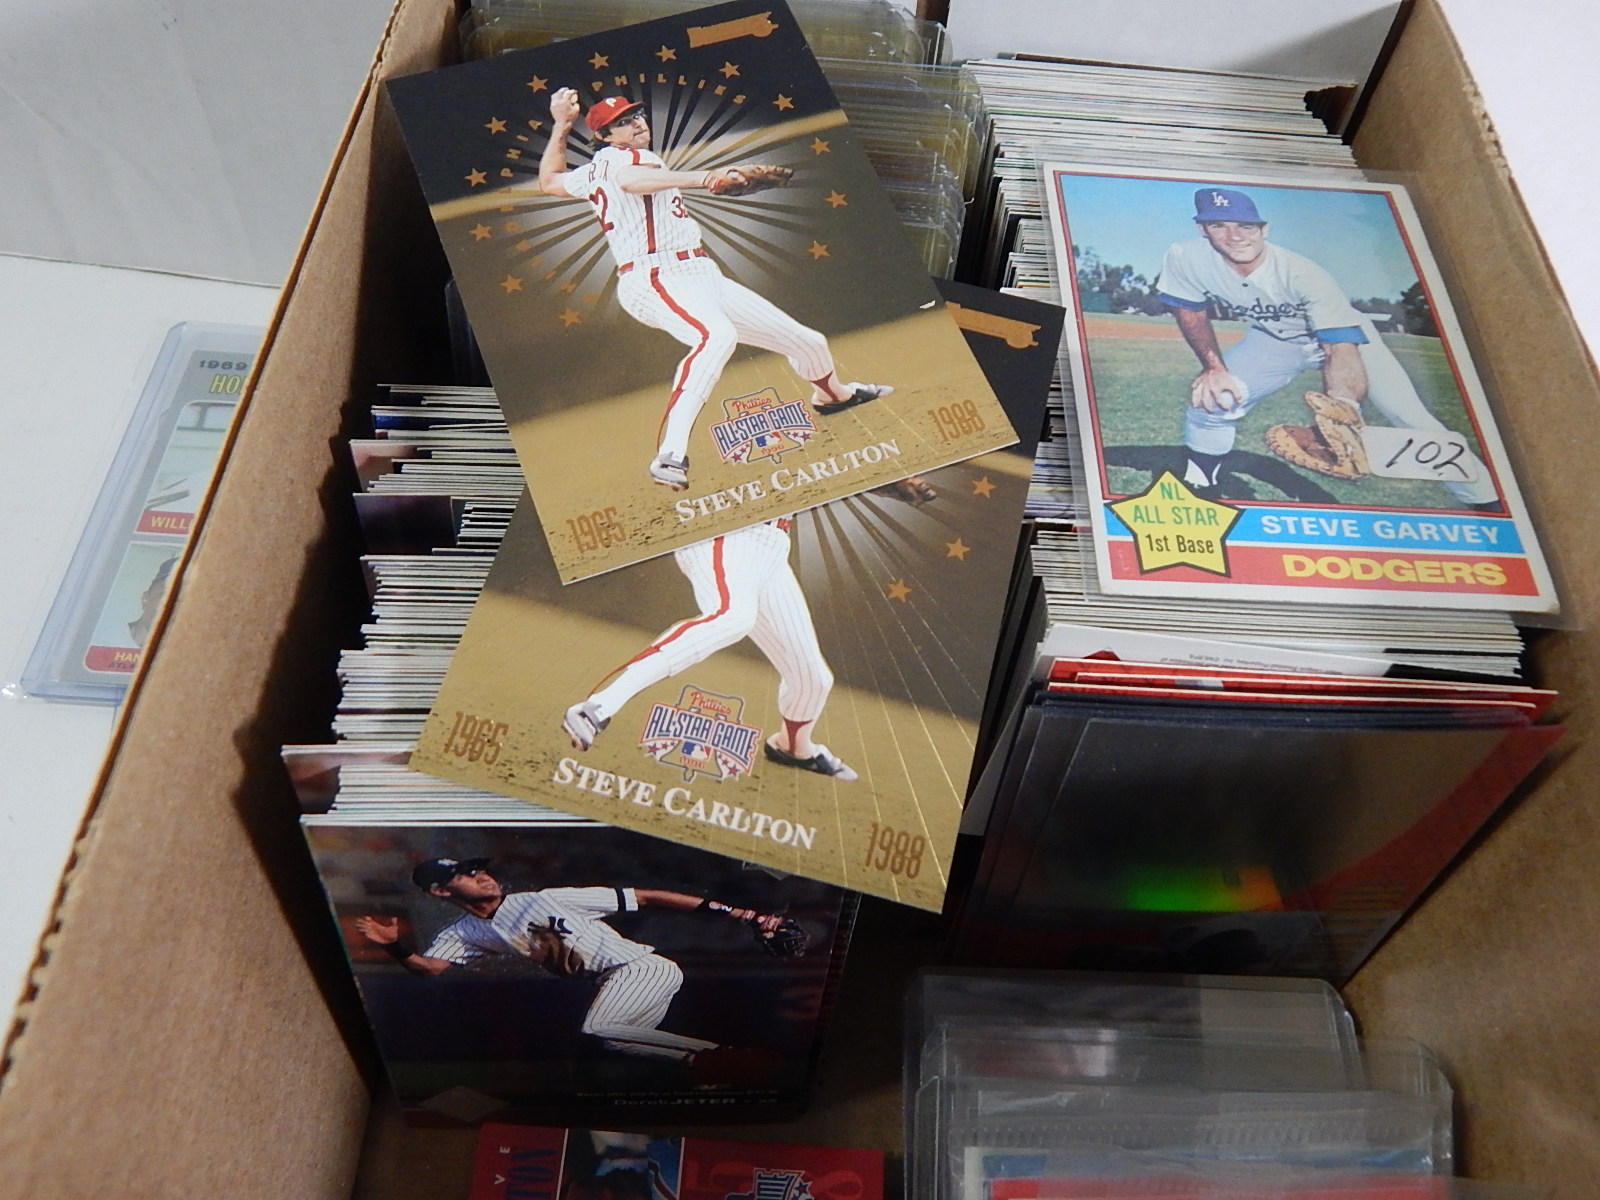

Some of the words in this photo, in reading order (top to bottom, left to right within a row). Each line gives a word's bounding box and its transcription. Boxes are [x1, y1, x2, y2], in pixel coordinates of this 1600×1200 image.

[767, 401, 813, 431] GAME
[929, 399, 987, 444] 1988
[674, 479, 768, 524] STEVE
[769, 437, 902, 493] CARLTON
[1160, 481, 1186, 501] NL
[569, 505, 627, 555] 1965
[1133, 504, 1167, 524] ALL
[1171, 506, 1220, 527] STAR
[1261, 514, 1362, 539] STEVE
[1372, 519, 1501, 546] GARVEY
[1145, 533, 1171, 552] 1st
[1176, 534, 1215, 554] Base
[1282, 554, 1508, 587] DODGERS
[442, 710, 509, 766] 1965
[711, 721, 758, 766] GAME
[552, 757, 657, 808] STEVE
[662, 787, 820, 851] CARLTON
[864, 821, 927, 880] 1988
